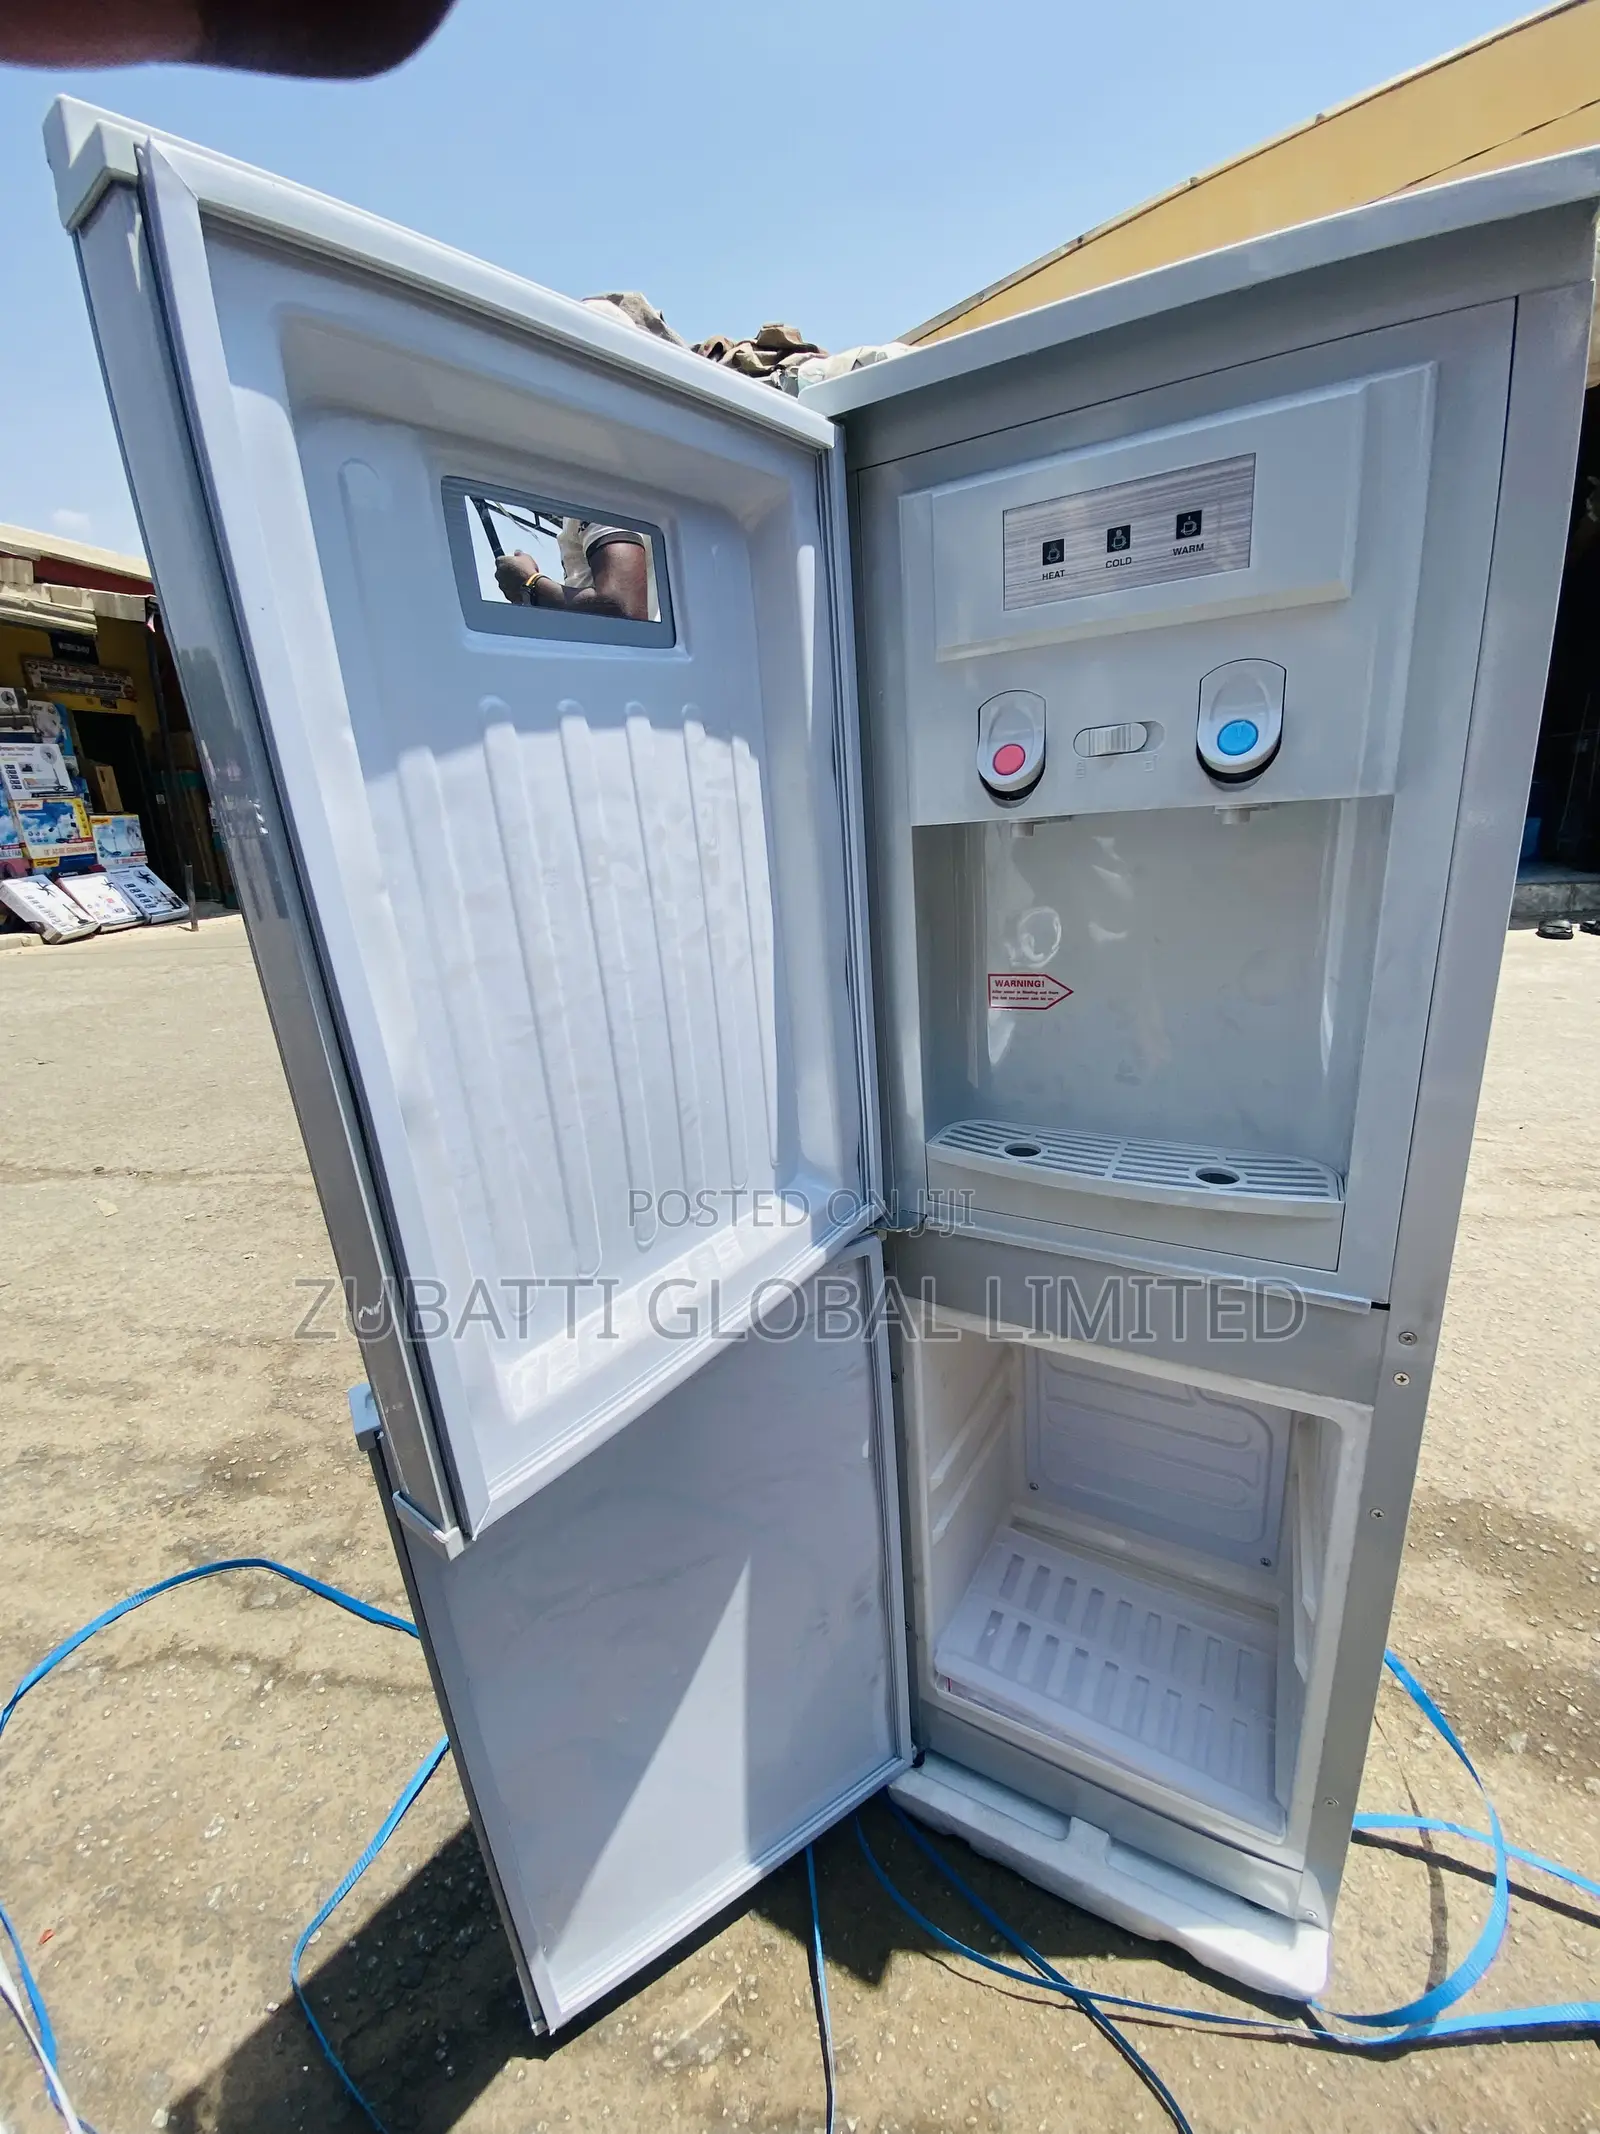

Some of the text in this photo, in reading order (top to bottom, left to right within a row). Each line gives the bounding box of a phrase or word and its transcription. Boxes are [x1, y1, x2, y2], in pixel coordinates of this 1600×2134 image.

[1172, 543, 1205, 556] WARM
[1105, 556, 1132, 569] COLD
[1041, 569, 1066, 581] HEAT
[994, 979, 1045, 988] WARNING!
